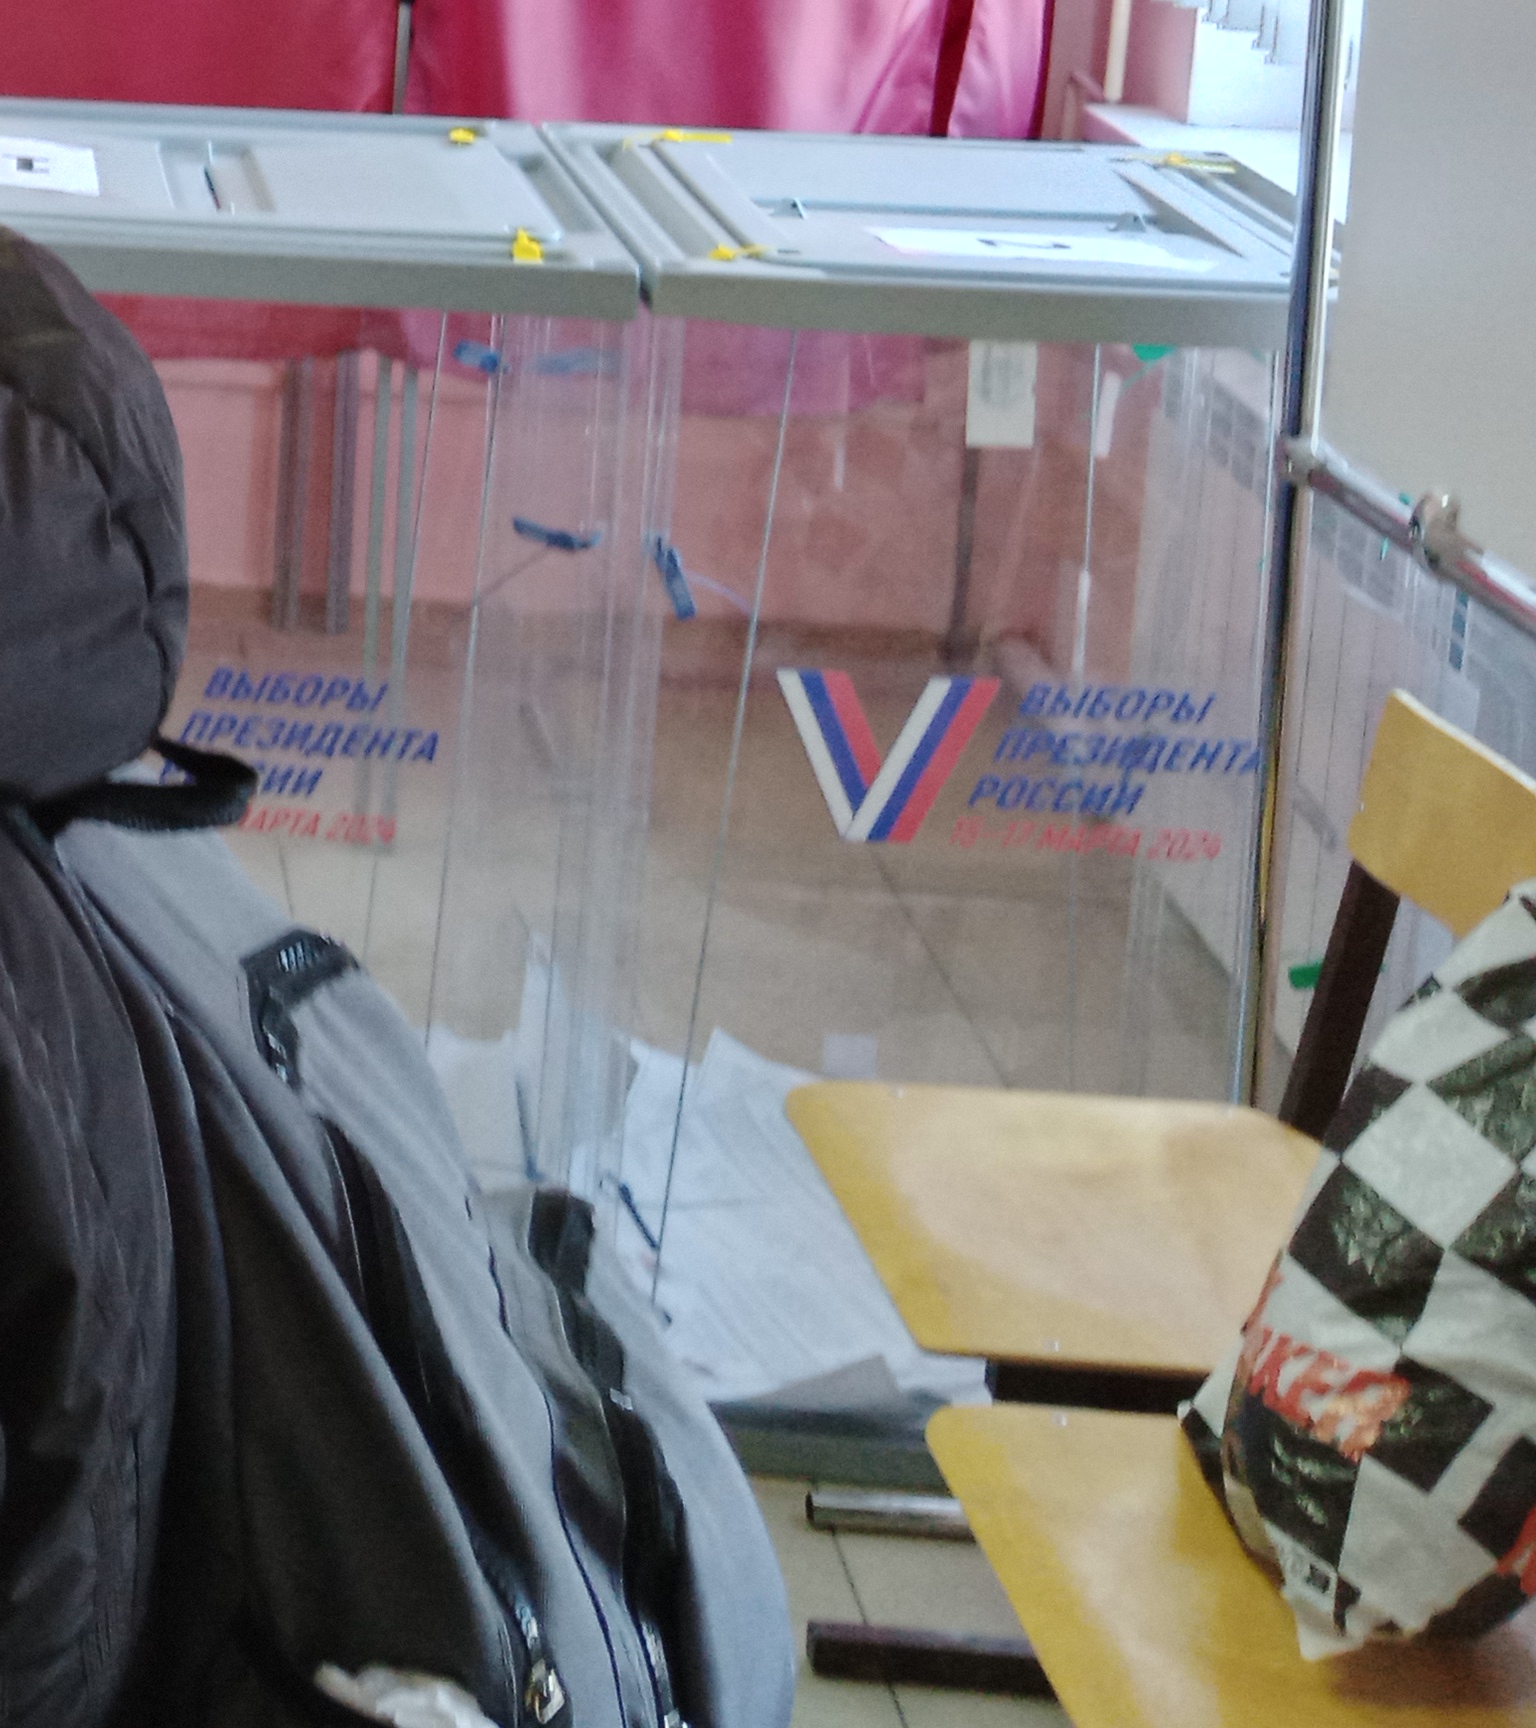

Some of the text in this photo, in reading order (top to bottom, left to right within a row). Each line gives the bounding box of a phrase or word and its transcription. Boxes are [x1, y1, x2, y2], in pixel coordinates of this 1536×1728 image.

[203, 666, 389, 712] ВЫБОРЫ
[1018, 681, 1216, 724] ВЫБОРЫ
[179, 709, 440, 763] ПРЕЗИДЕНТА
[968, 774, 1146, 817] РОССИИ
